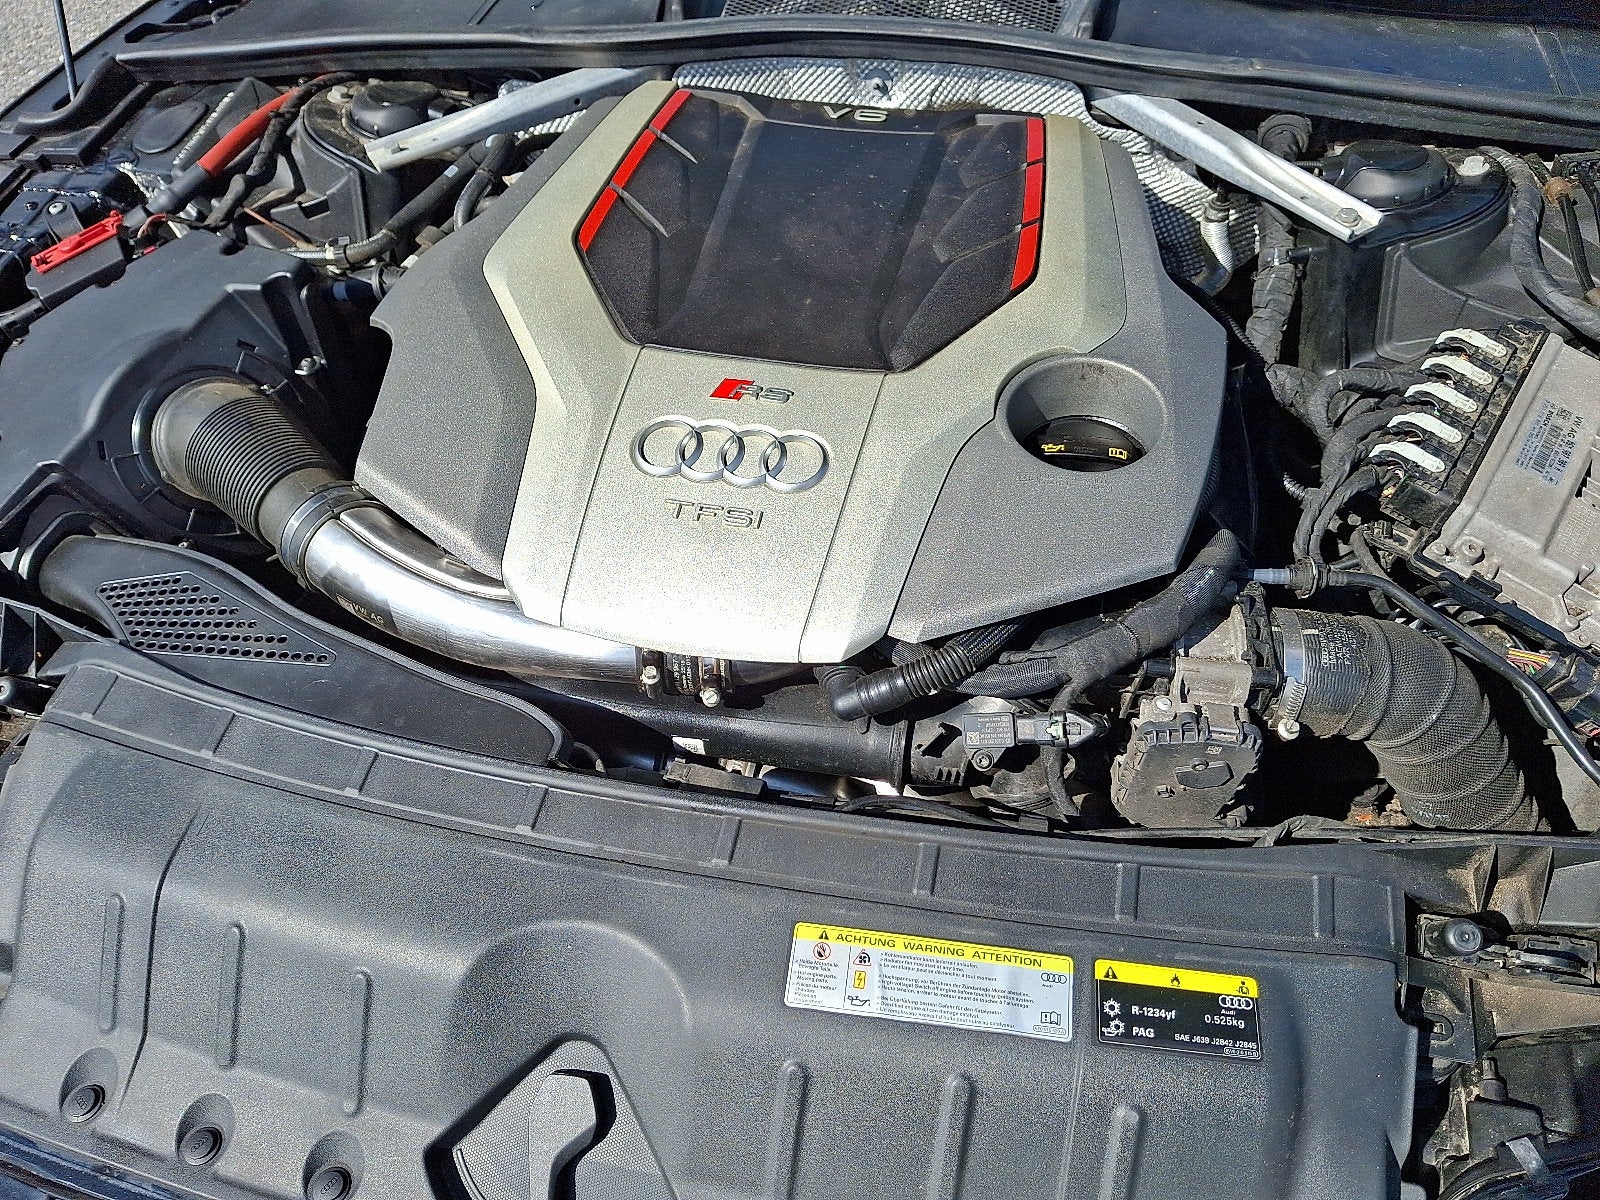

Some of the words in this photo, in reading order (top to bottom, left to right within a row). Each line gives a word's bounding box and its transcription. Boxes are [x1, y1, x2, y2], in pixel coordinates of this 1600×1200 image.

[823, 105, 888, 122] V6
[709, 378, 795, 404] RS
[1573, 415, 1584, 429] VW
[1567, 428, 1577, 439] AG
[665, 498, 764, 529] TFSI
[836, 933, 896, 948] ACHTUNG
[903, 941, 965, 957] WARNING
[972, 950, 1042, 967] ATTENTION
[1131, 1005, 1176, 1020] R-1234yf
[1220, 1008, 1236, 1016] Audi
[1204, 1014, 1245, 1029] 0.525kg
[1132, 1026, 1155, 1038] PAG
[1174, 1033, 1190, 1042] SAE
[1191, 1036, 1210, 1045] J639
[1211, 1038, 1233, 1047] J2842
[1234, 1041, 1257, 1050] J2845
